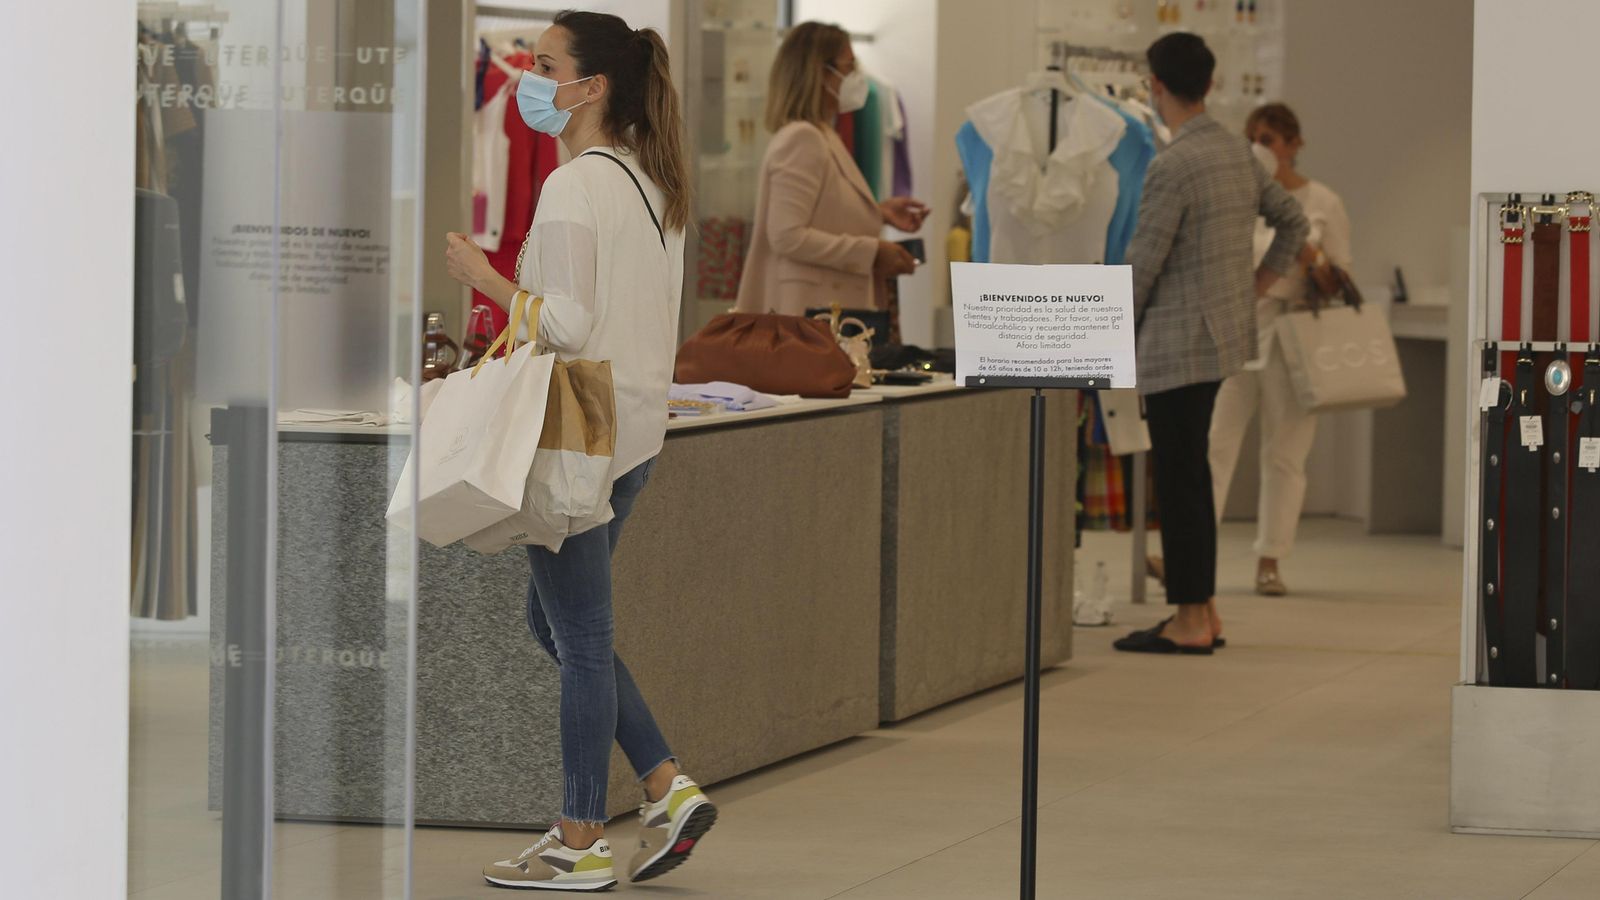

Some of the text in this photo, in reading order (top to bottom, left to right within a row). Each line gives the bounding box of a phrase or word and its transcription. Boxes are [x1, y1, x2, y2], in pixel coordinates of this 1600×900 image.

[980, 294, 1104, 303] ¡BIENVENIDOS DE NUEVO!
[963, 303, 994, 312] Nuestra
[996, 305, 1032, 314] prioridad
[1044, 305, 1053, 313] la
[1055, 305, 1076, 313] salud
[1078, 304, 1089, 313] de
[963, 312, 991, 321] clientes
[1054, 314, 1067, 322] Por
[1070, 313, 1092, 323] favor,
[1110, 312, 1124, 323] gel
[967, 320, 1027, 331] hidroalcohólico
[1036, 324, 1071, 332] recuerda
[1111, 321, 1120, 330] la
[998, 331, 1089, 342] distancia de seguridad.
[1016, 340, 1072, 349] Aforo limitado
[987, 356, 1010, 364] horario
[1314, 340, 1388, 371] COS
[1050, 365, 1064, 374] 12h,
[1065, 364, 1094, 372] teniendo
